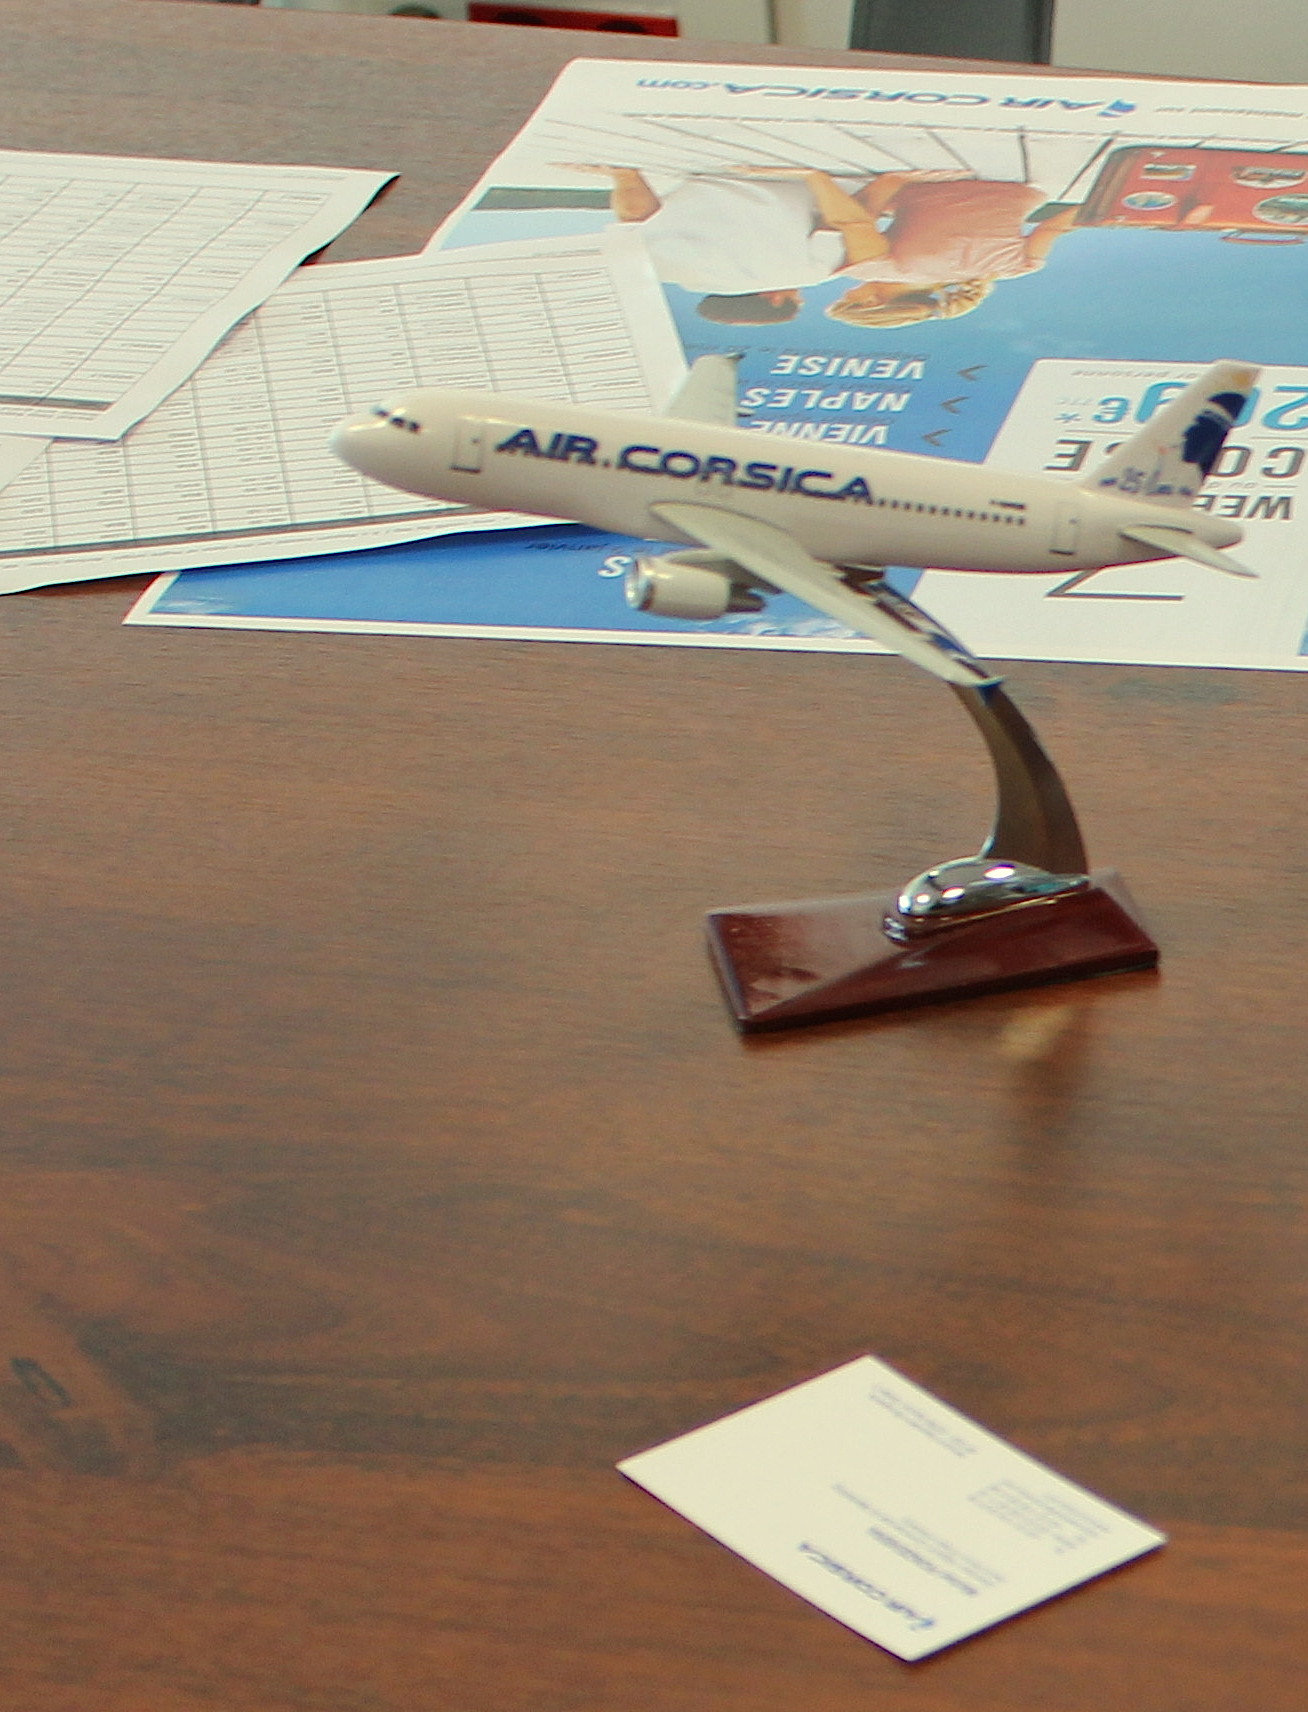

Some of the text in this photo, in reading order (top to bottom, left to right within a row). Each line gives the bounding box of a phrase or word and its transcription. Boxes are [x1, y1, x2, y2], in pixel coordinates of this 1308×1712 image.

[636, 79, 1102, 110] AIR CORSICA.com
[770, 353, 926, 380] VENISE
[739, 386, 912, 411] NAPLES
[749, 419, 889, 445] VIENNE
[495, 429, 874, 503] AIR CORSICA
